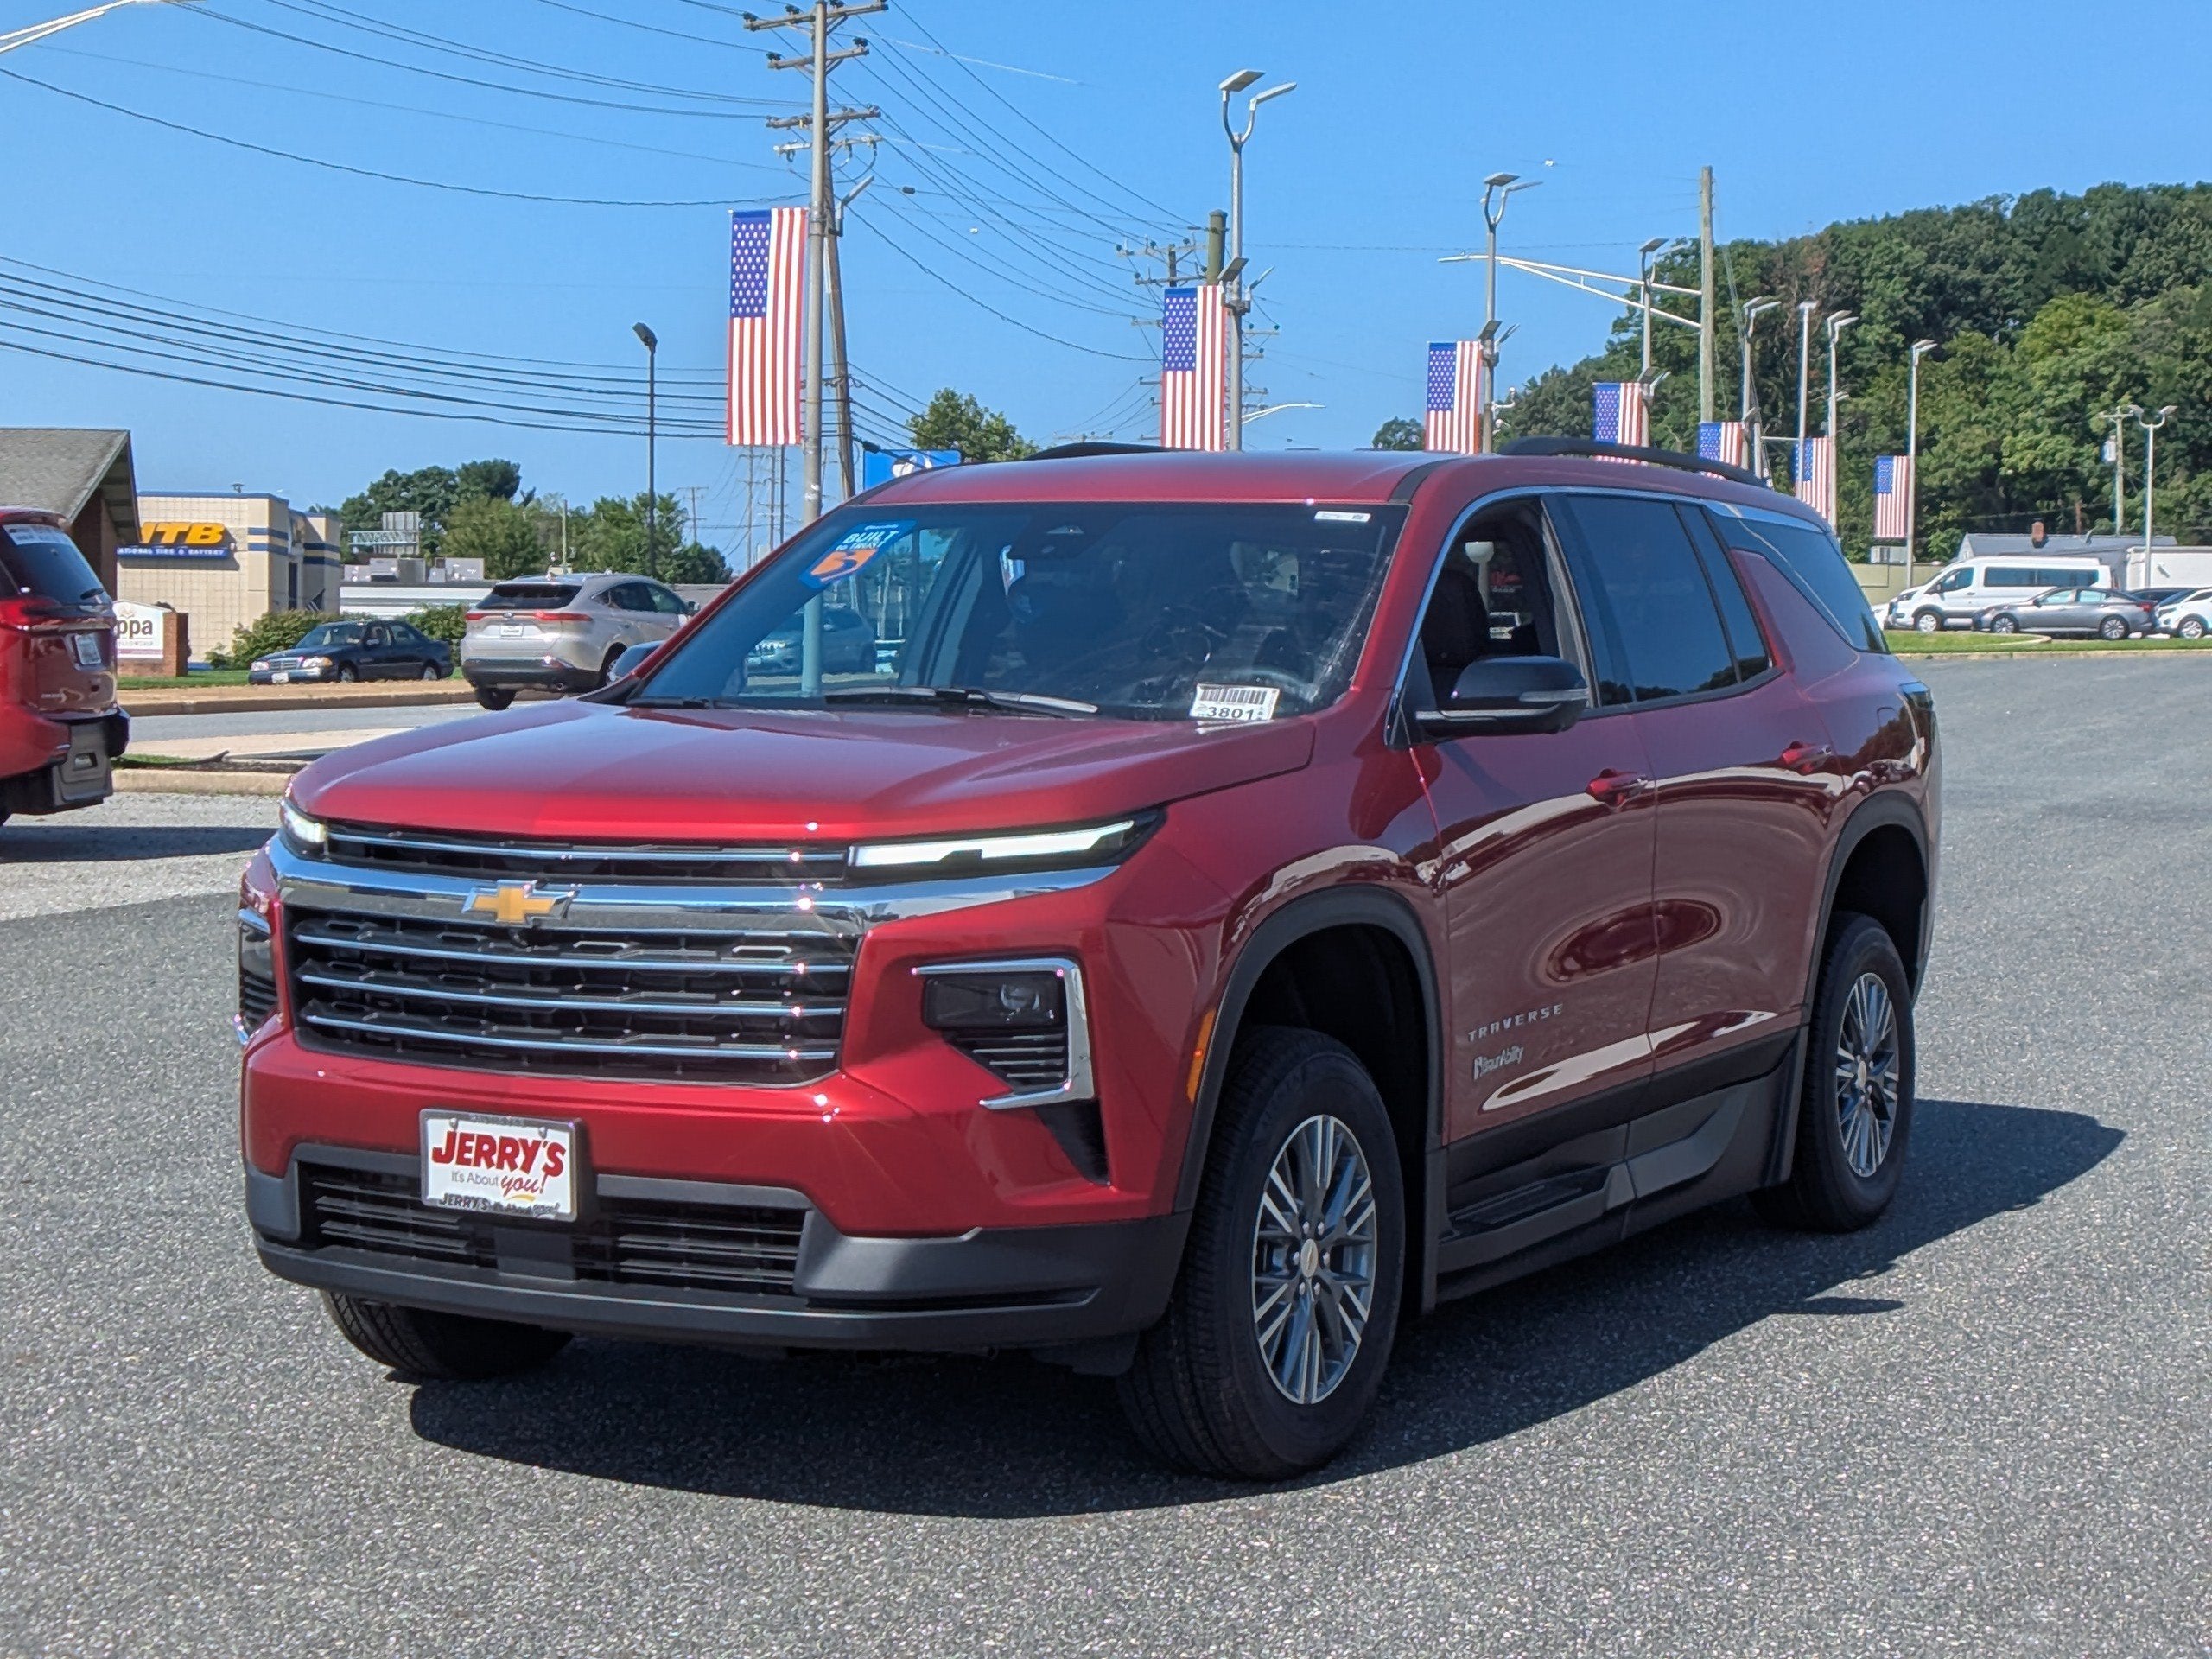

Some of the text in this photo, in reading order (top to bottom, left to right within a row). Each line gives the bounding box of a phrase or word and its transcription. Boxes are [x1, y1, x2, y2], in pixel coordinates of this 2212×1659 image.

[1468, 1003, 1563, 1042] TRAVERSE
[431, 1130, 567, 1179] JERRY'S
[451, 1170, 547, 1198] It's About you!
